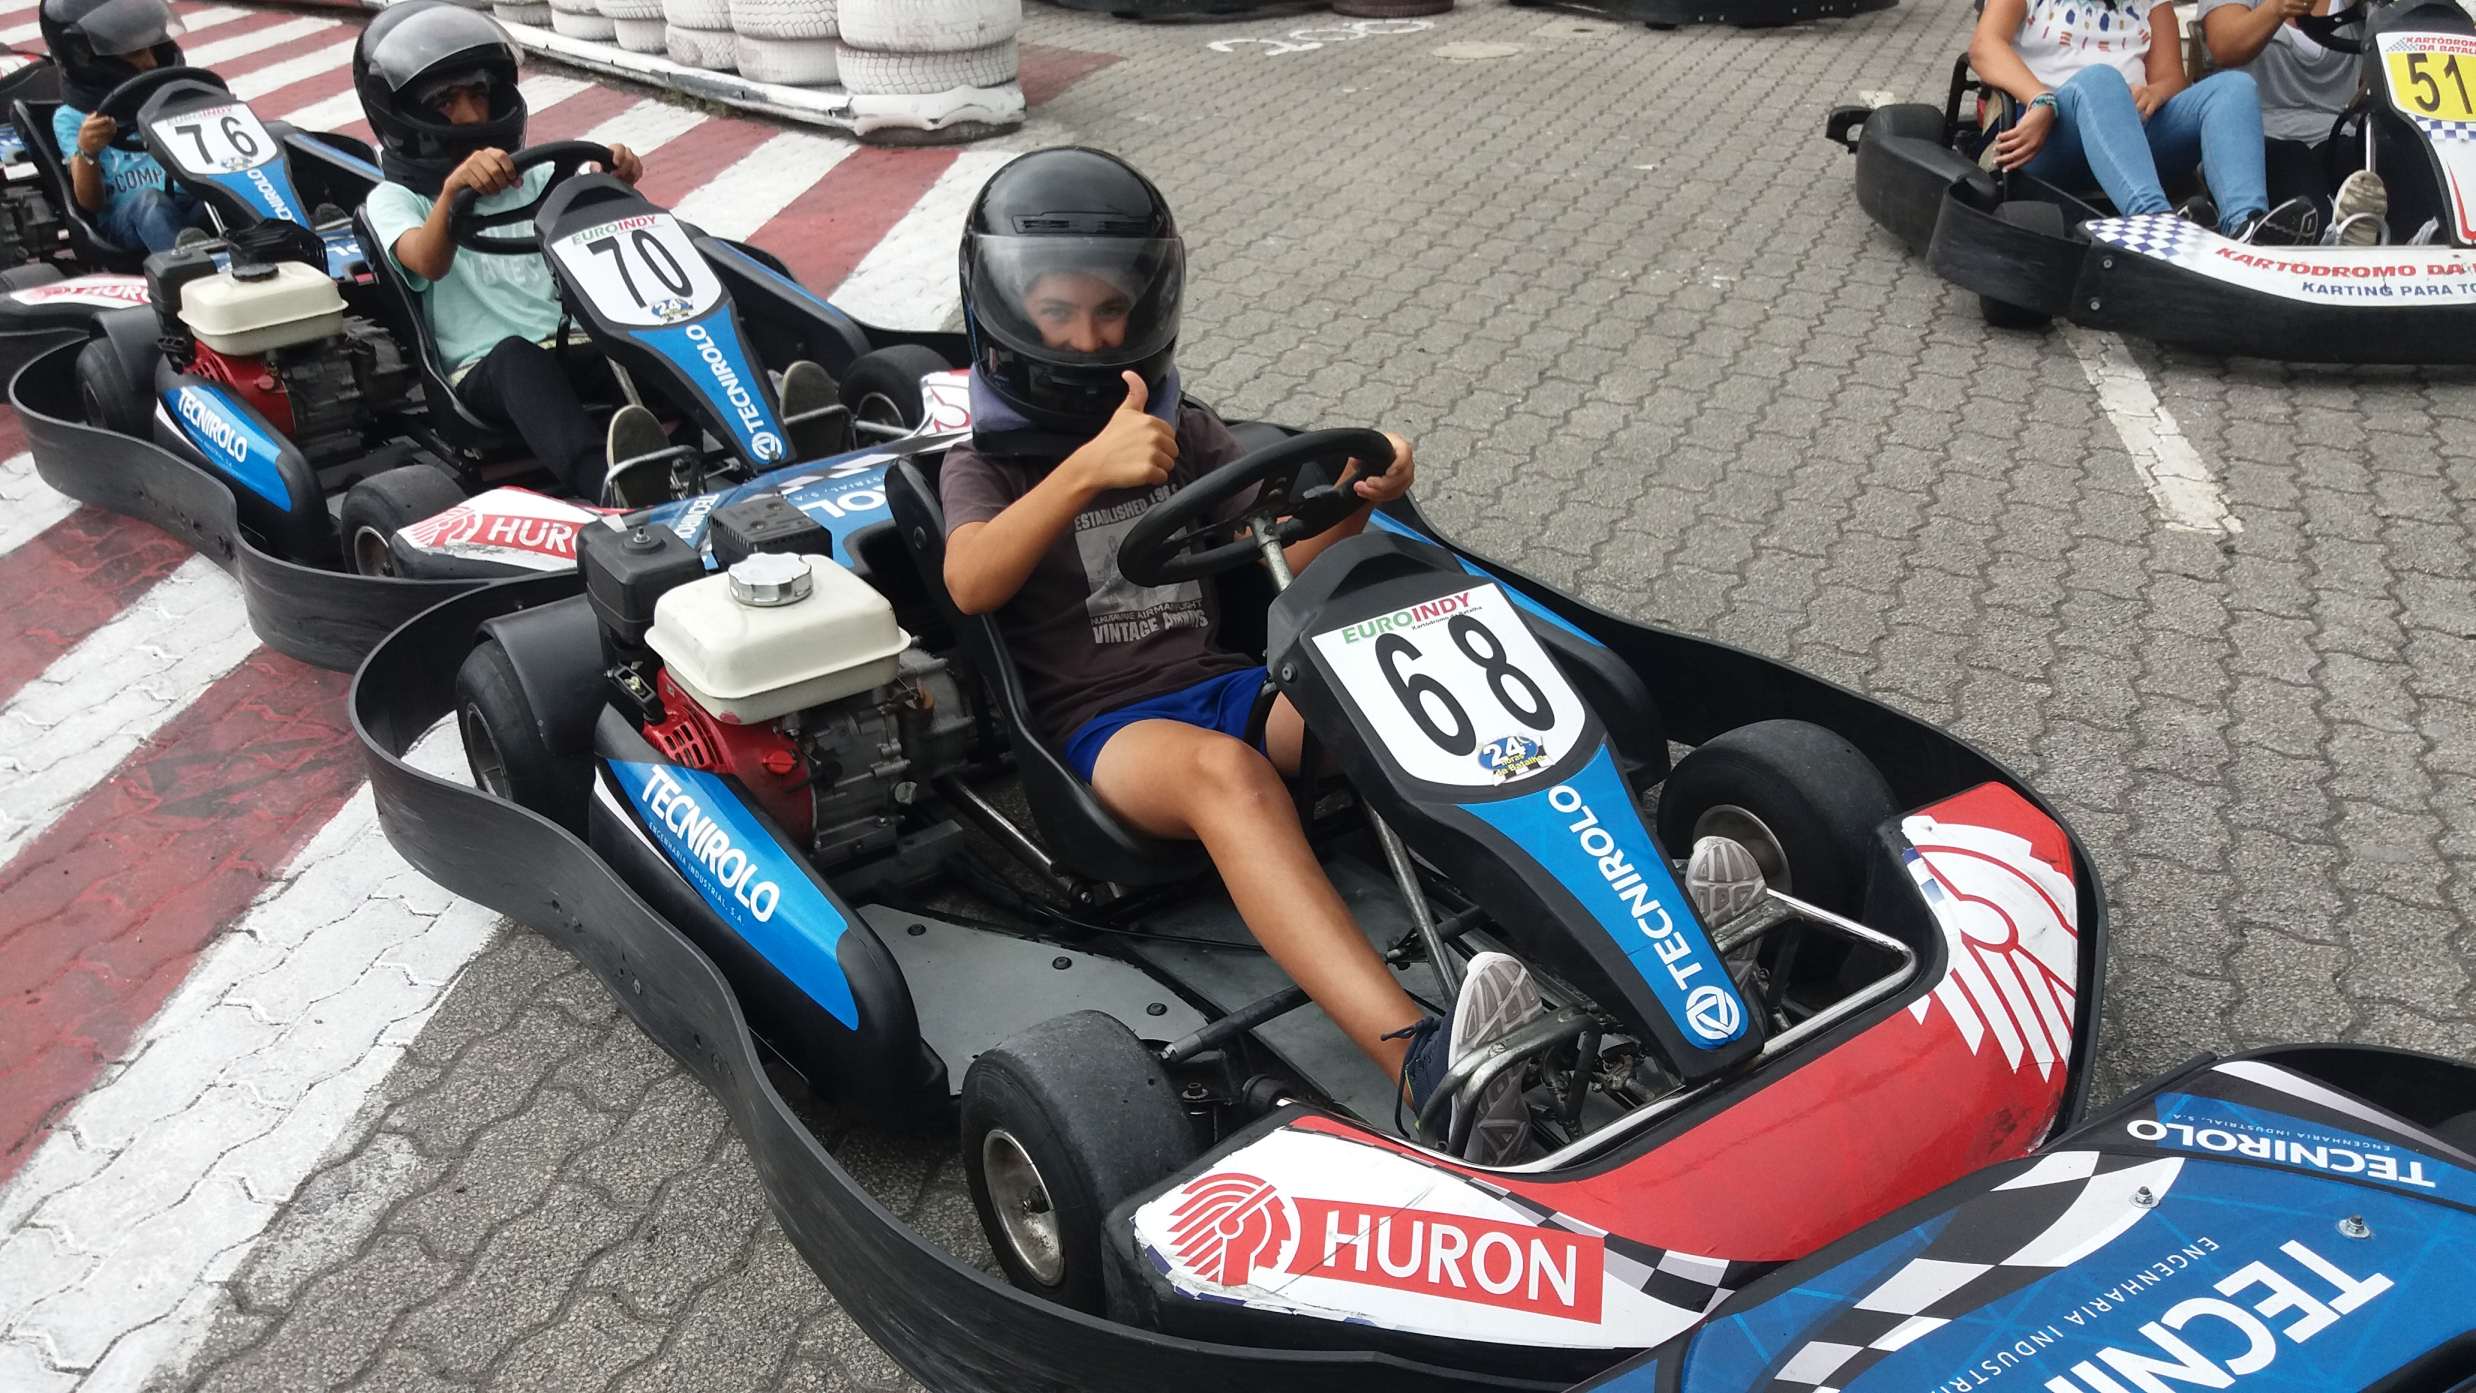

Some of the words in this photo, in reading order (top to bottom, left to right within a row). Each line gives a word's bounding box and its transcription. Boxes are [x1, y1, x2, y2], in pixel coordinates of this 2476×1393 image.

[2439, 46, 2476, 55] BATAL
[2407, 52, 2473, 114] 51
[175, 116, 259, 165] 76
[571, 216, 657, 246] EUROINDY
[586, 229, 693, 308] 70
[2302, 281, 2393, 297] KARTING
[2400, 284, 2453, 297] PARA
[2427, 263, 2465, 275] DA
[685, 324, 764, 434] TECNIROLO
[178, 386, 248, 463] TECNIROLO
[487, 517, 578, 553] HUR
[1074, 498, 1149, 531] ESTABLISHED
[1092, 617, 1161, 643] VINTAGE
[1342, 592, 1471, 644] EUROINDY
[1374, 612, 1555, 756] 68
[1483, 736, 1526, 767] 24
[642, 764, 780, 923] TECNIROLO
[649, 821, 686, 865] ENGENHARIA
[1548, 785, 1703, 991] TECNIROLO
[2126, 1119, 2436, 1188] TECNIROLO
[2296, 1132, 2391, 1151] ENGENHARIA
[1324, 1209, 1577, 1307] HURON
[2065, 1236, 2219, 1324] ENGENHARIA
[2044, 1239, 2395, 1393] TECNI
[1931, 1324, 2064, 1393] INDUSTRI
